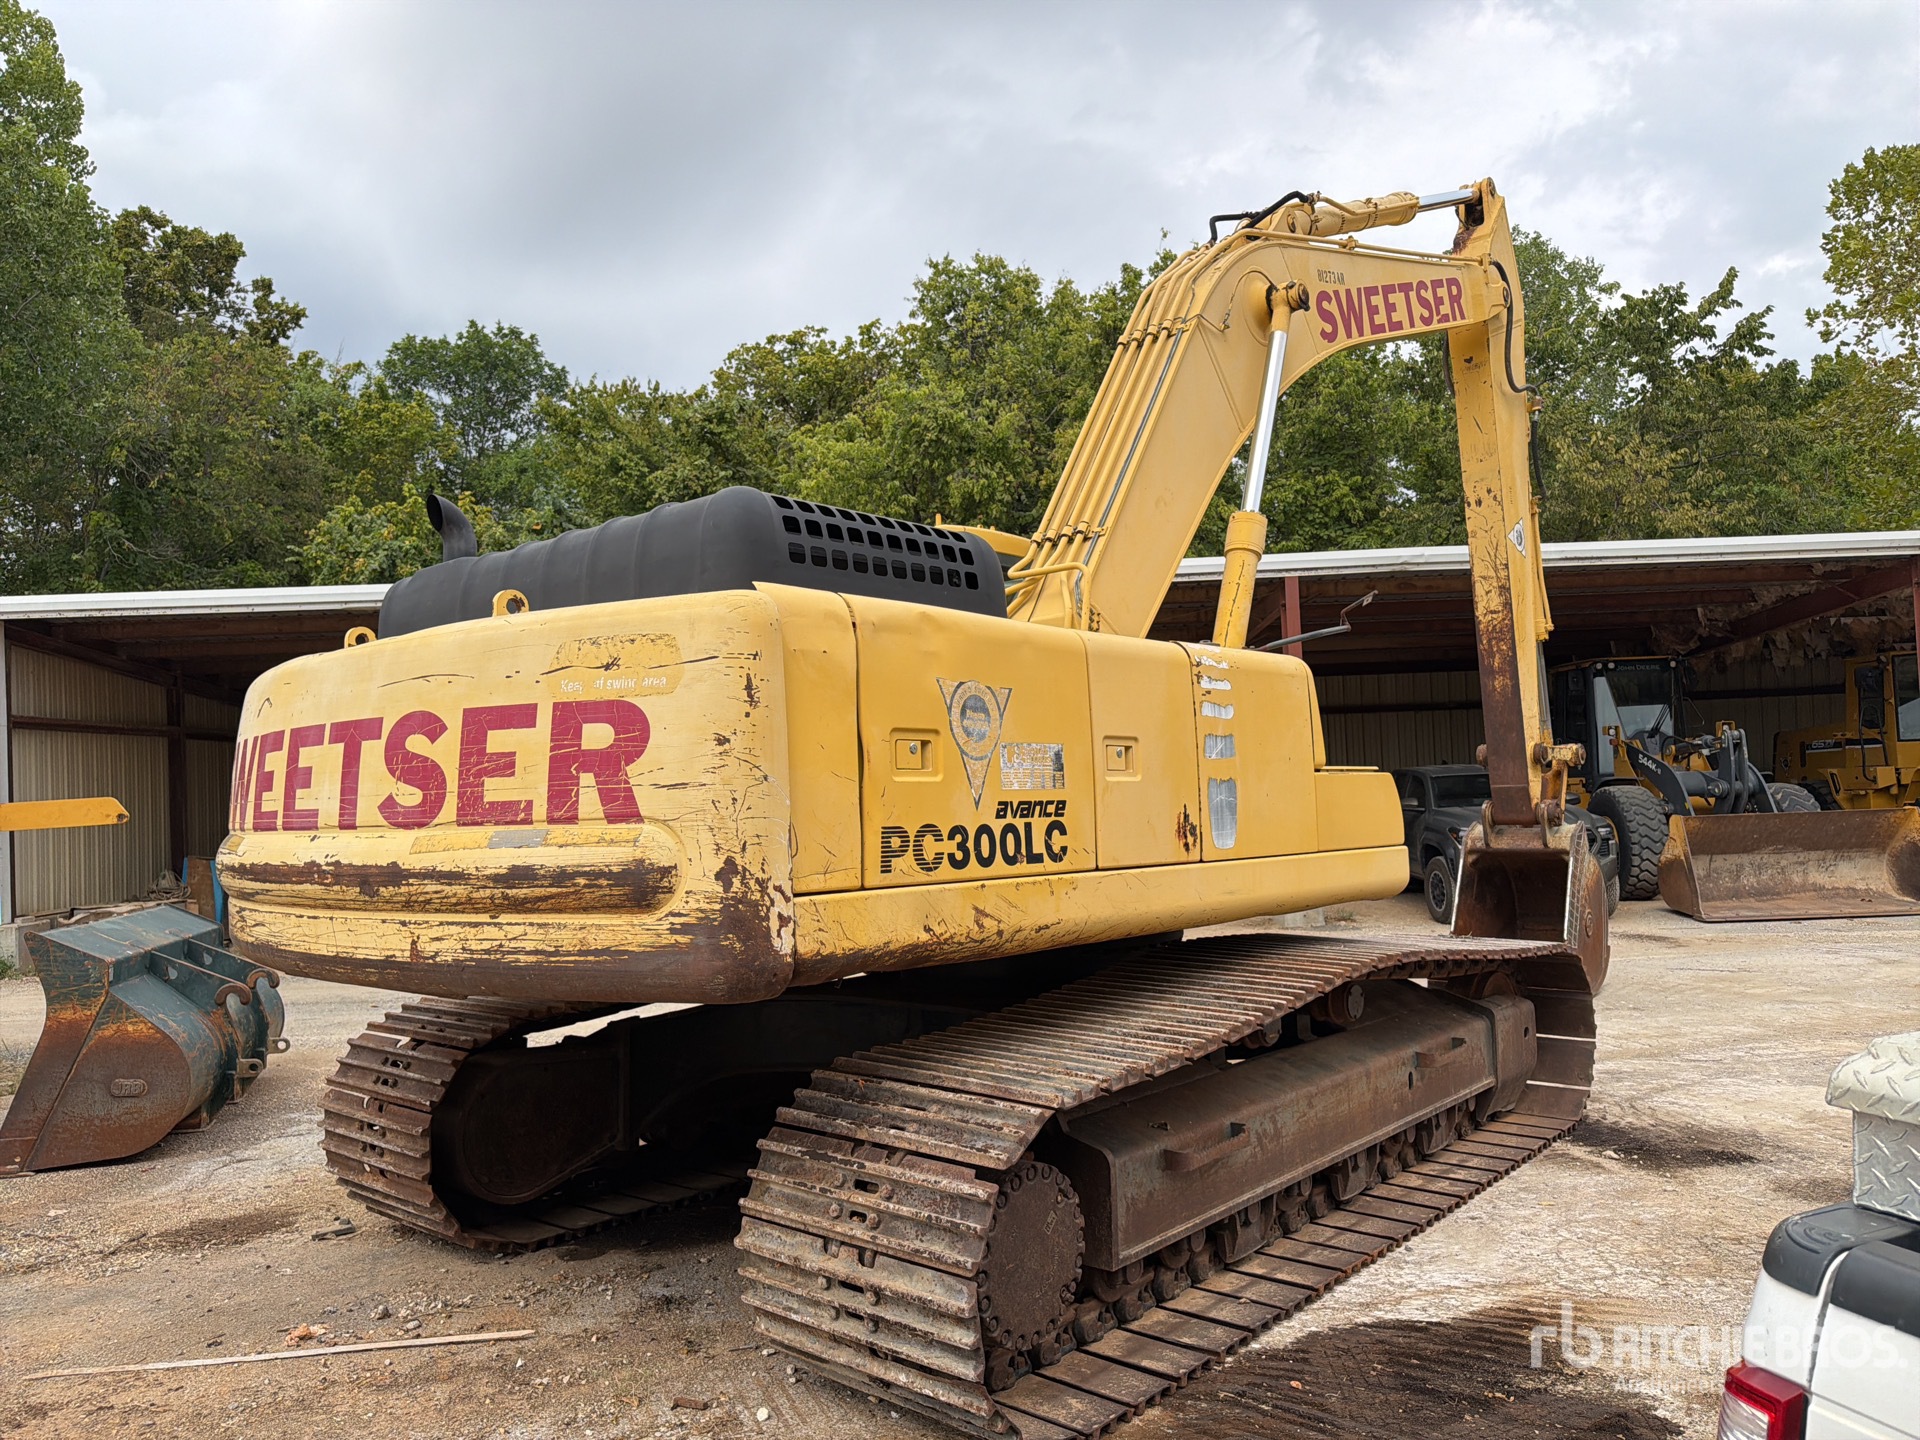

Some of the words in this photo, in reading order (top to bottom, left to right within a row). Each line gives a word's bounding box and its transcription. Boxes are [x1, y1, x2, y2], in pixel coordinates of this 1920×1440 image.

[1316, 277, 1466, 343] SWEETSER
[642, 676, 667, 688] area
[995, 800, 1067, 819] avance
[880, 820, 1068, 874] PC300LC
